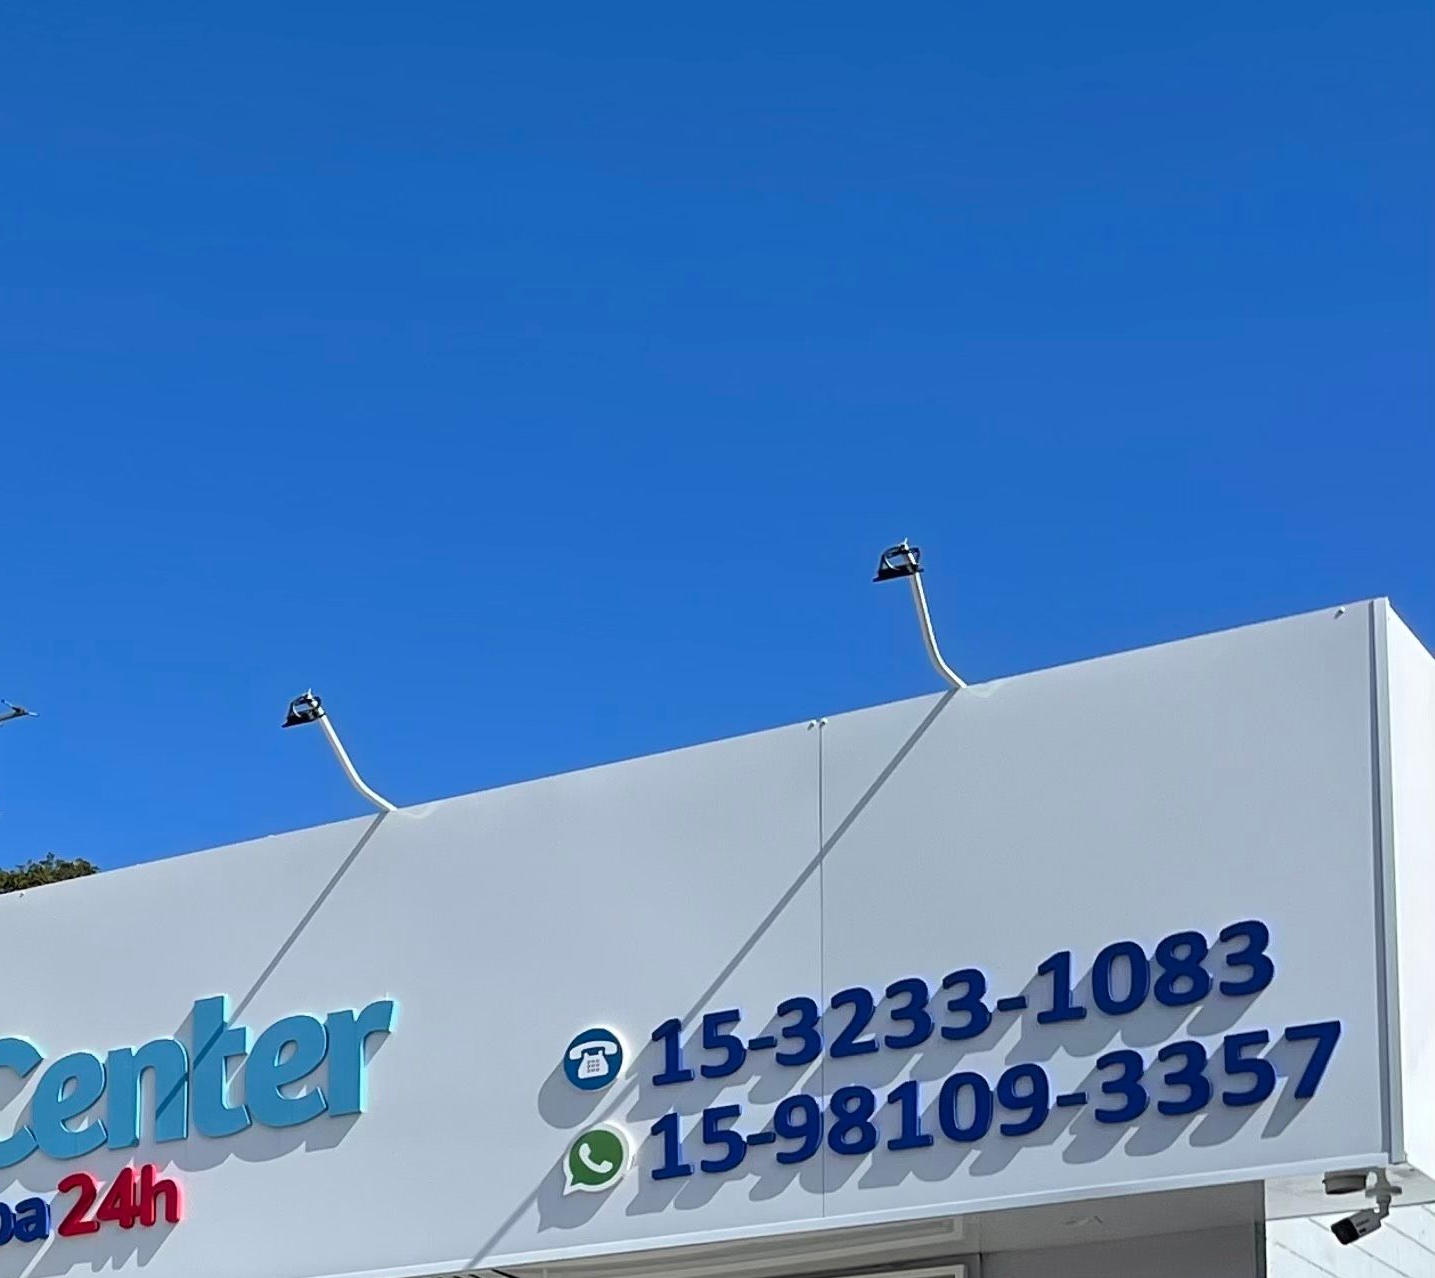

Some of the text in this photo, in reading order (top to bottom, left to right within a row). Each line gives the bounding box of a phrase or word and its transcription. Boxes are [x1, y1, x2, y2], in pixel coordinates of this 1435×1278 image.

[652, 920, 1275, 1086] 15-3233-1083
[651, 1021, 1342, 1181] 15-98109-3357
[57, 1163, 184, 1237] 24h
